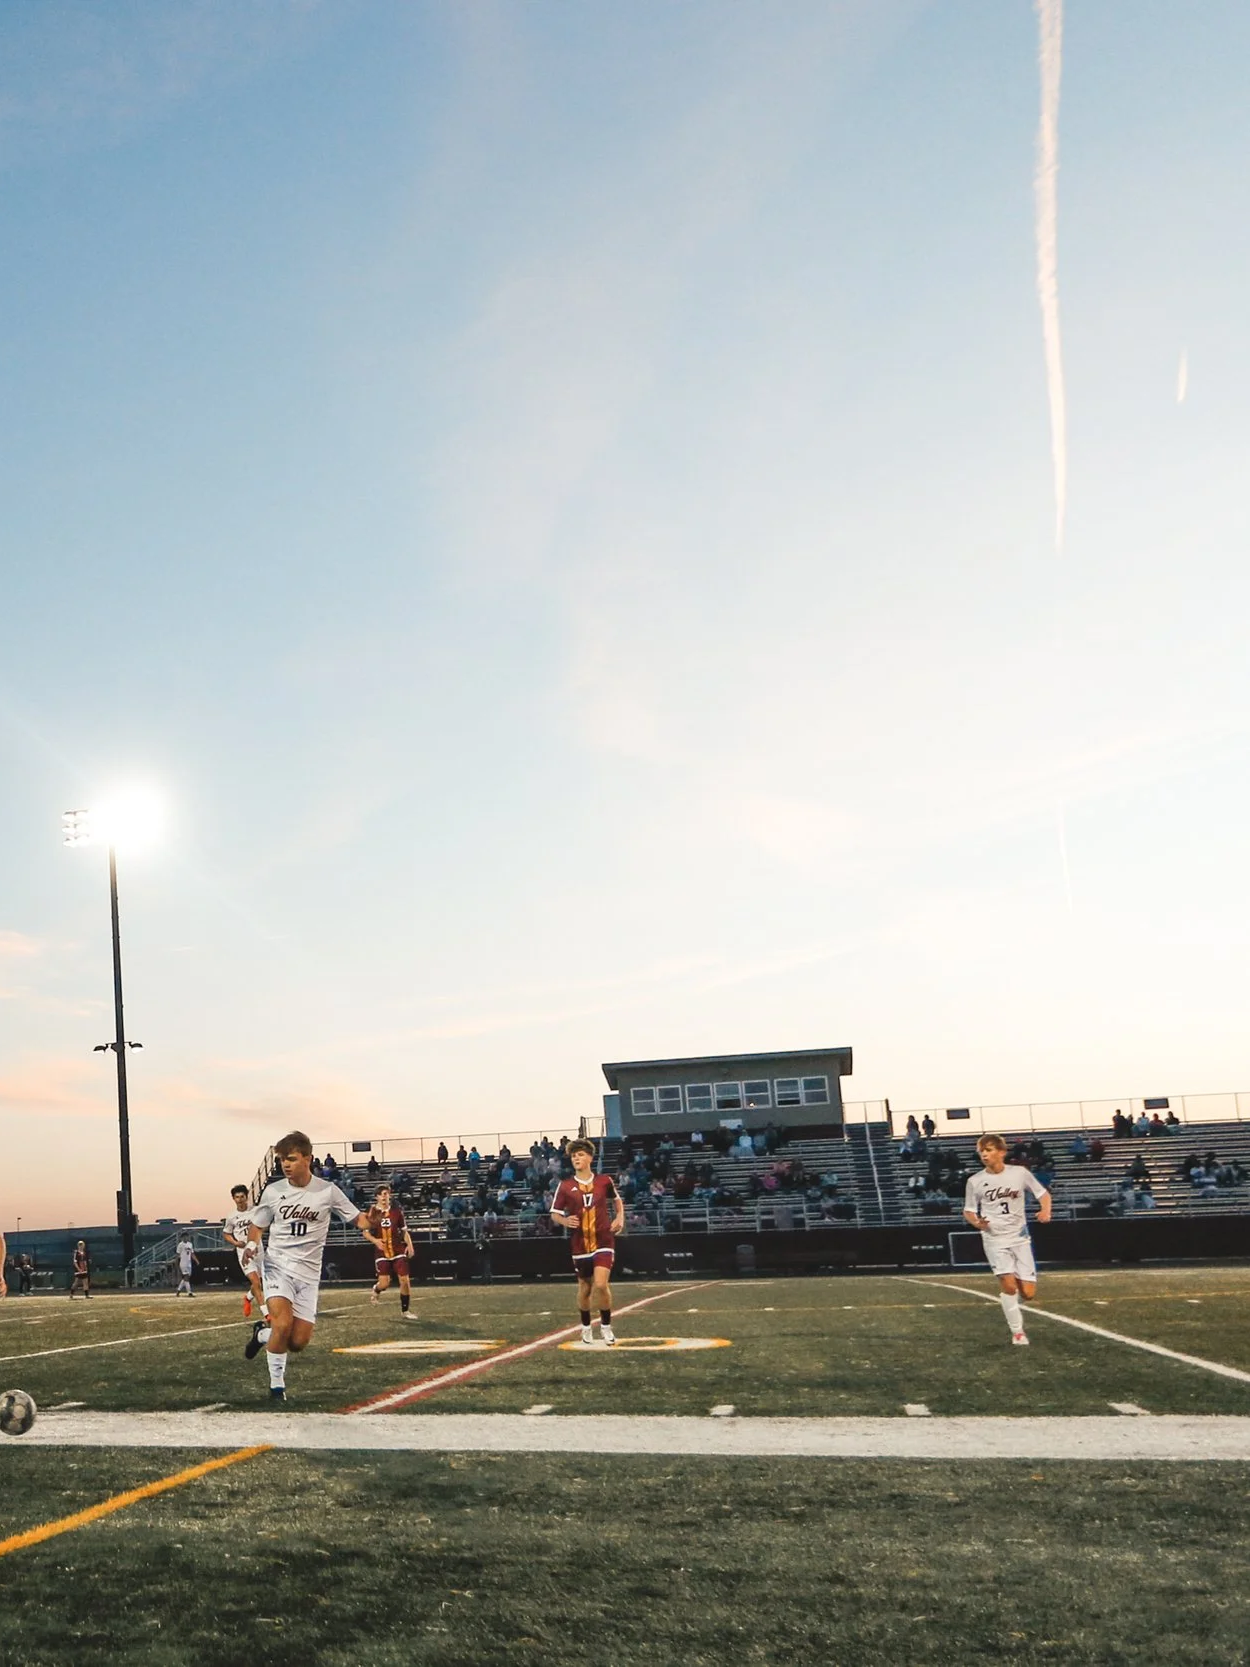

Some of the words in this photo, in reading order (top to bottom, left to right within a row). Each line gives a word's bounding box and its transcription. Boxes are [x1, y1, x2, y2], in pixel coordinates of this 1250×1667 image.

[583, 1193, 593, 1207] 17
[985, 1187, 1020, 1201] Valley
[279, 1204, 320, 1221] Valley
[1000, 1202, 1009, 1214] 3
[291, 1222, 307, 1236] 10
